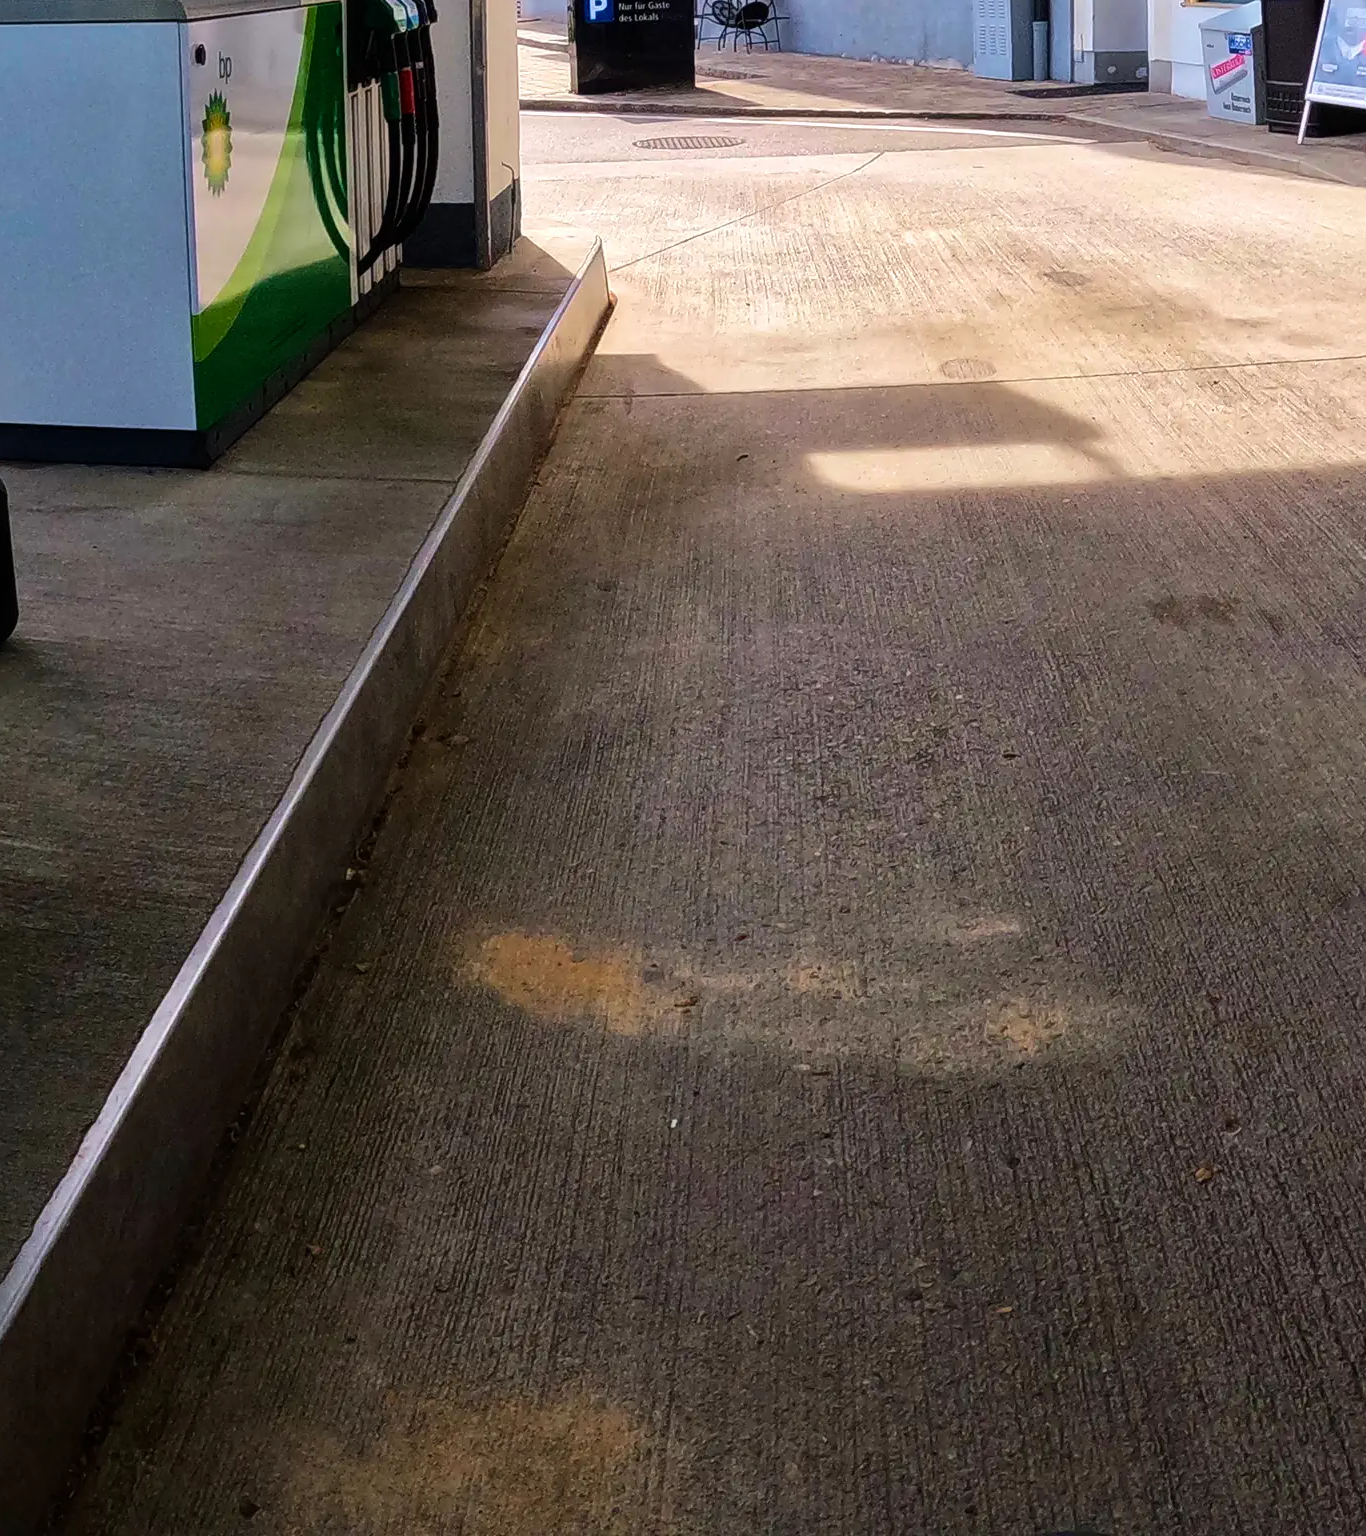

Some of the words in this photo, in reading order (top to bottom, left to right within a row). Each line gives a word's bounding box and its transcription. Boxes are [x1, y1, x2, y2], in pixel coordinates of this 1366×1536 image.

[618, 3, 632, 11] Nur
[635, 1, 646, 10] für
[619, 14, 632, 22] des
[635, 13, 659, 21] Lokals
[218, 51, 232, 84] bp
